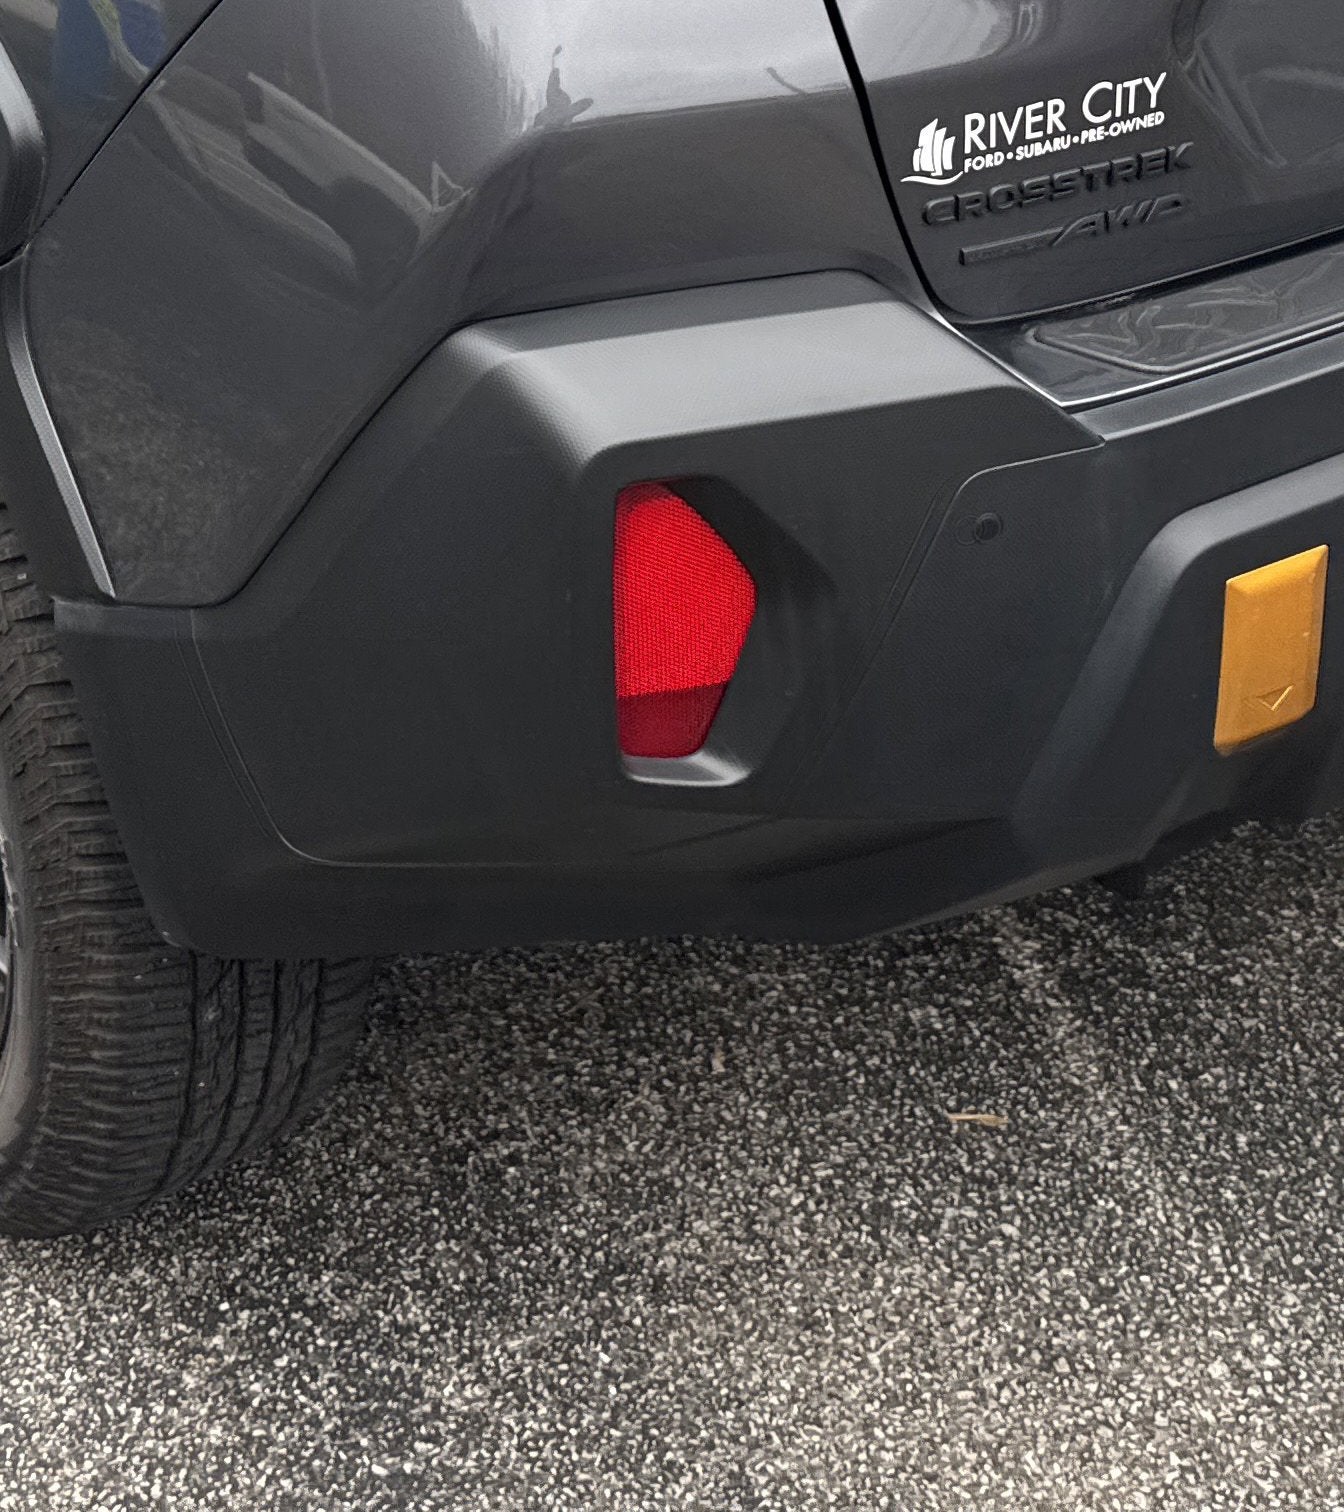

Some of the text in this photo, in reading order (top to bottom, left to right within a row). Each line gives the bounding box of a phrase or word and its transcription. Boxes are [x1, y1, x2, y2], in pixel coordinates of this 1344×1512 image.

[964, 72, 1166, 154] RIVER CITY
[964, 111, 1165, 173] FORD SUBARU PRE-OWNED
[922, 141, 1194, 225] CROSSTREK
[1049, 193, 1186, 246] AWD
